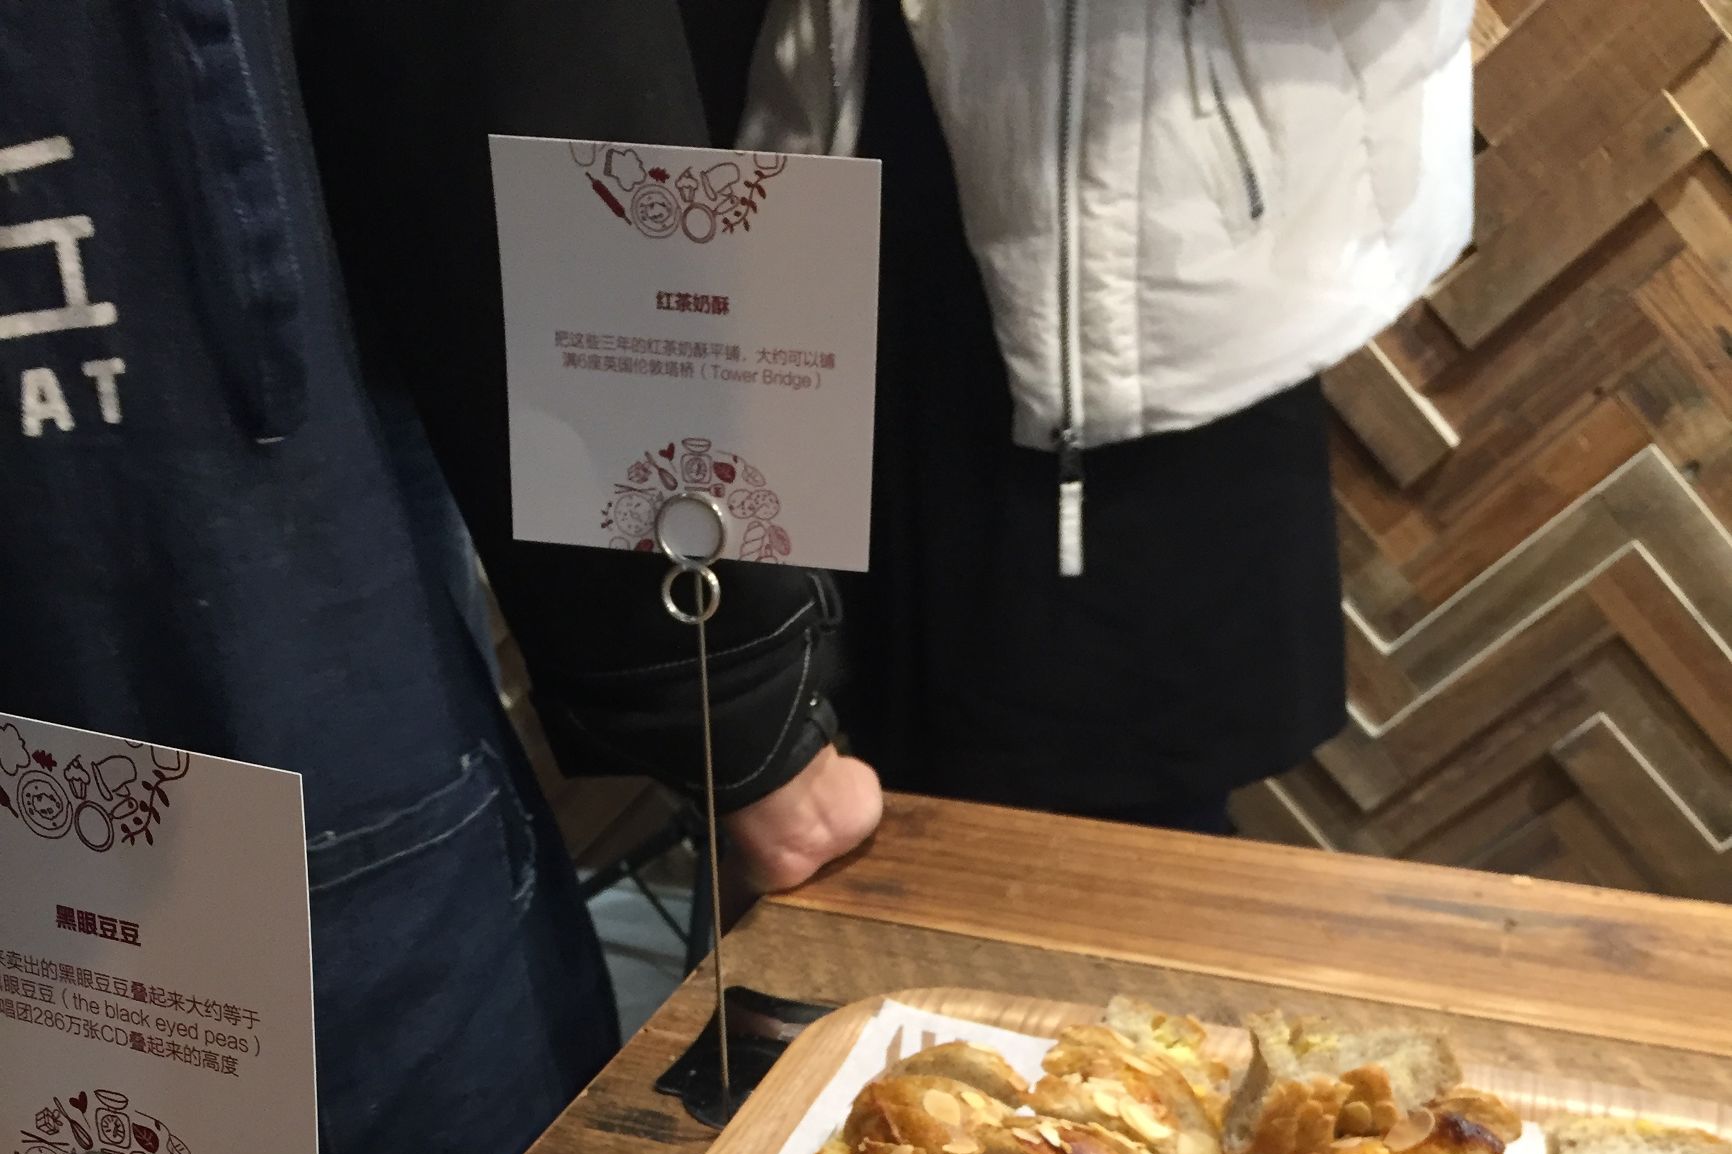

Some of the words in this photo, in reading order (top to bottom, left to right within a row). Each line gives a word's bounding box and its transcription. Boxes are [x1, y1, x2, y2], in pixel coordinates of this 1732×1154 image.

[656, 290, 730, 315] 红茶奶酥
[56, 904, 141, 947] 黑眼豆豆
[105, 1002, 150, 1029] black
[156, 1015, 198, 1039] eyed
